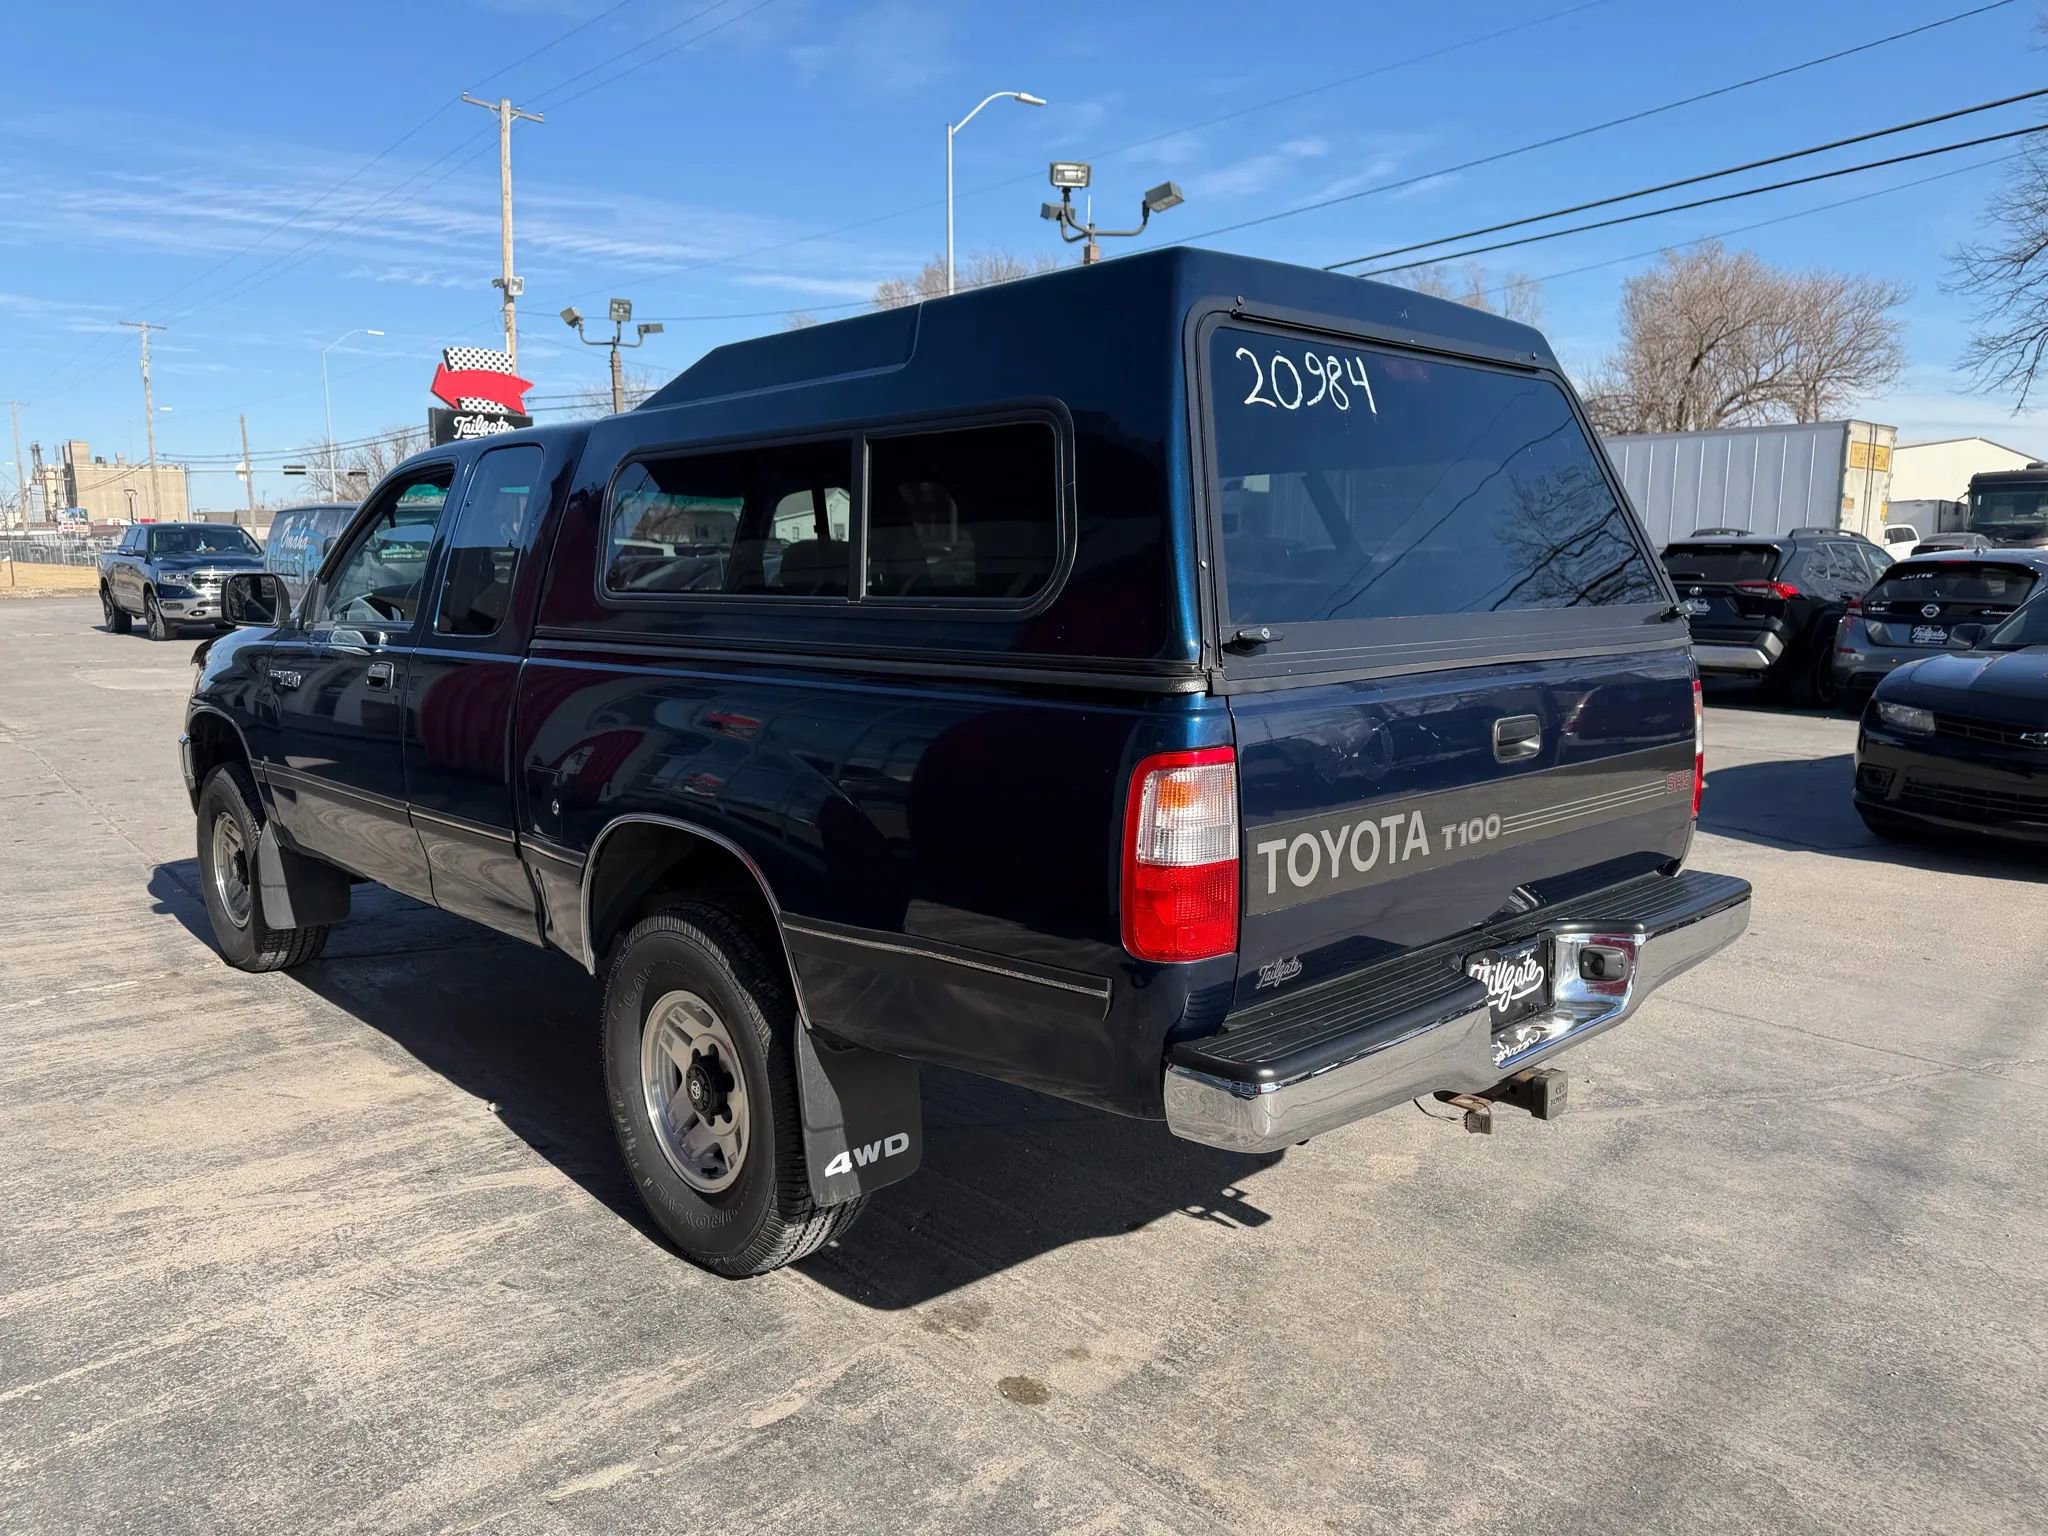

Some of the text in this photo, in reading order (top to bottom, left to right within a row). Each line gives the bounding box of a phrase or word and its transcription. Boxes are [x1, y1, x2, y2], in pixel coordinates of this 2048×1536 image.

[1235, 347, 1378, 414] 20984
[280, 526, 309, 550] Omaha
[1257, 810, 1430, 894] TOYOTA
[1441, 813, 1501, 851] T100
[1255, 956, 1303, 990] Tailgate
[824, 1132, 910, 1178] 4WD
